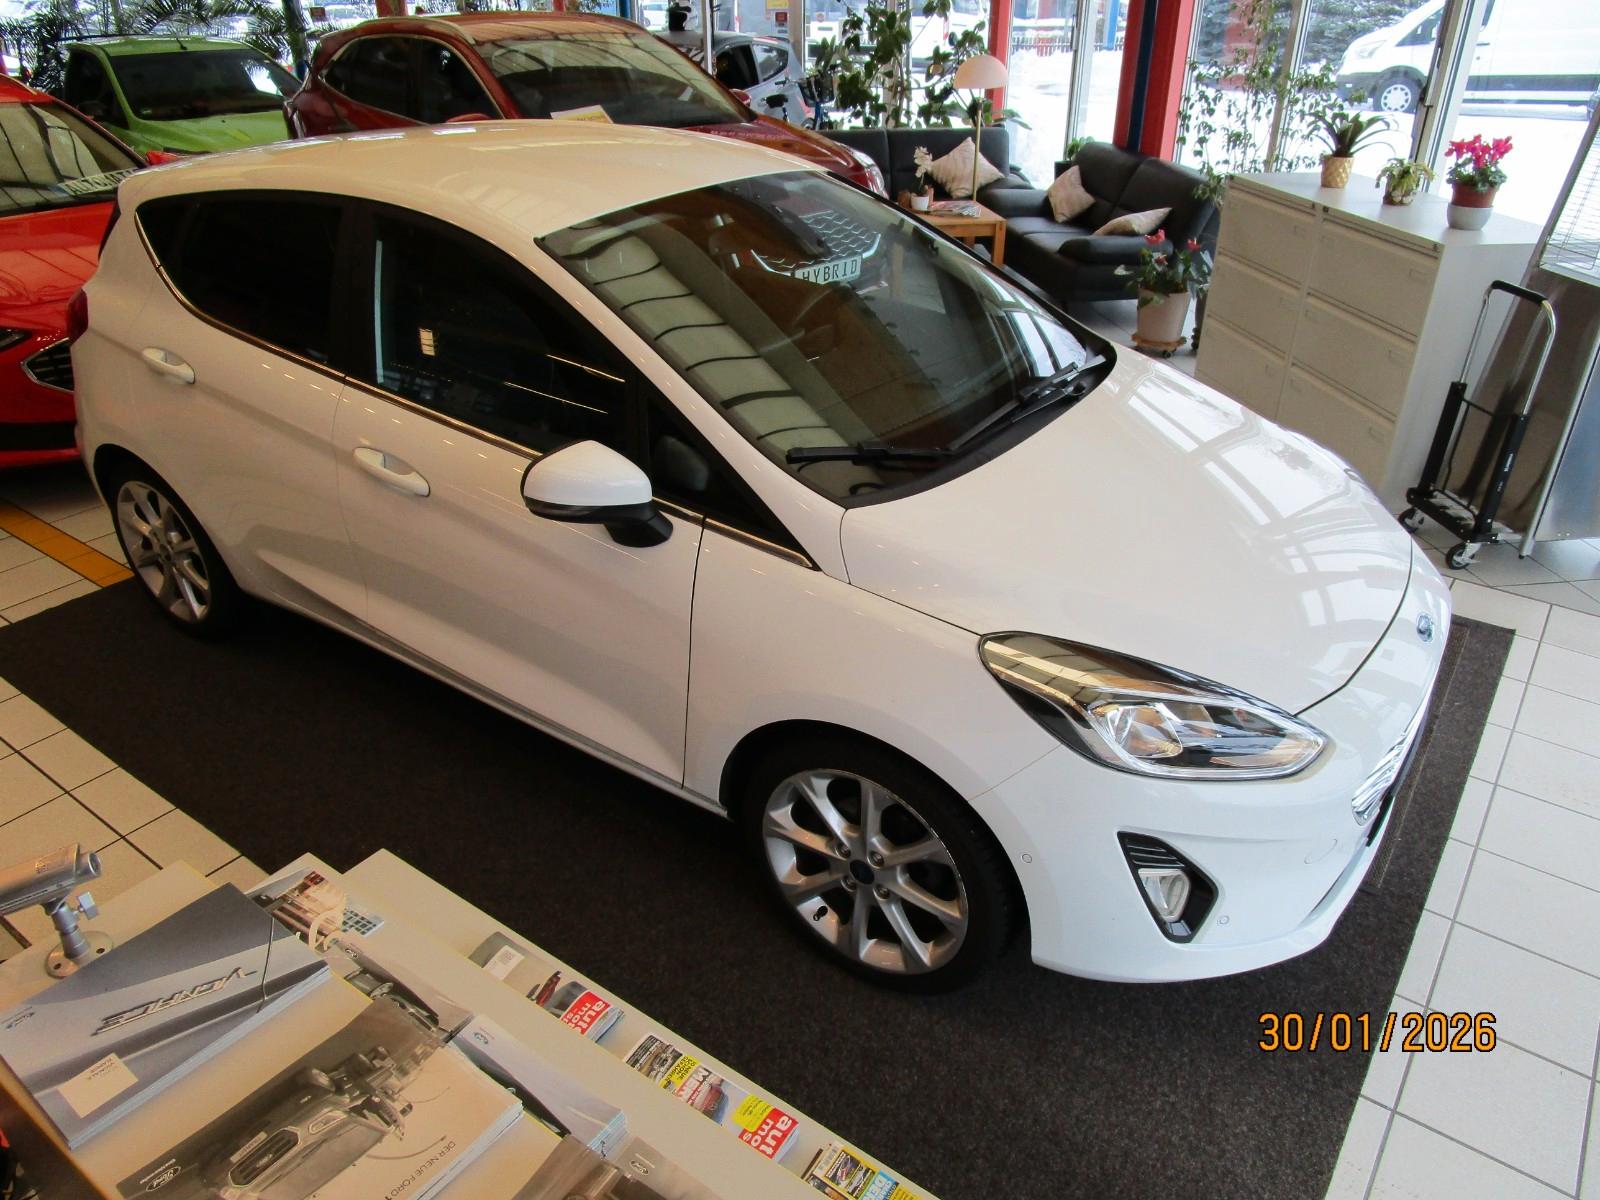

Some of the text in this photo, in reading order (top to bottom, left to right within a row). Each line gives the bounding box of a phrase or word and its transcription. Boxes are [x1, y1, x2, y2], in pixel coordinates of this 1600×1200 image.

[802, 259, 858, 283] HYBRID
[391, 1140, 456, 1197] DER NEUE FORD
